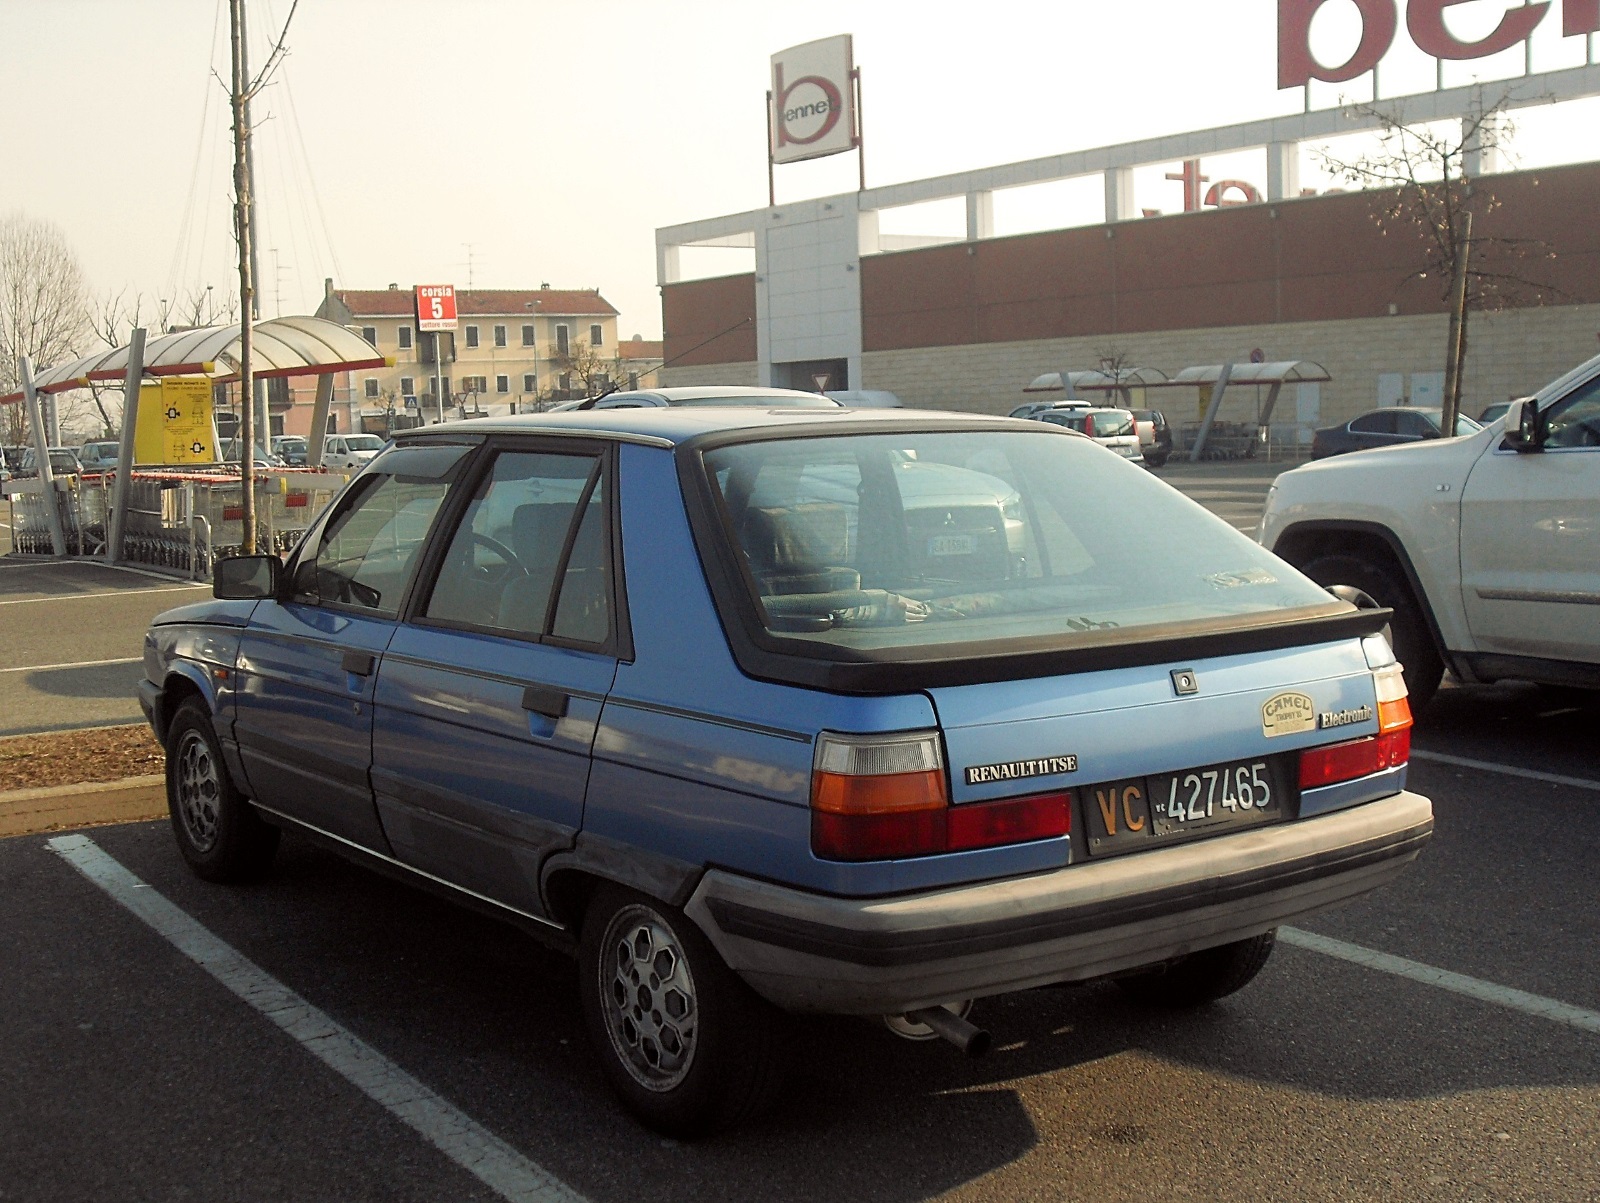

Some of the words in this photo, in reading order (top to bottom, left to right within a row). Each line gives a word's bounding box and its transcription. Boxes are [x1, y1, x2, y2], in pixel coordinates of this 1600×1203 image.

[1278, 0, 1600, 90] be
[421, 286, 452, 297] corsia
[431, 297, 443, 319] 5
[1265, 696, 1310, 717] CAMEL
[1320, 703, 1373, 729] Electronic
[969, 761, 1037, 783] RENAULT
[1038, 759, 1049, 774] 11
[1049, 756, 1077, 772] TSE
[1096, 785, 1145, 836] VC
[1168, 763, 1271, 822] 427465
